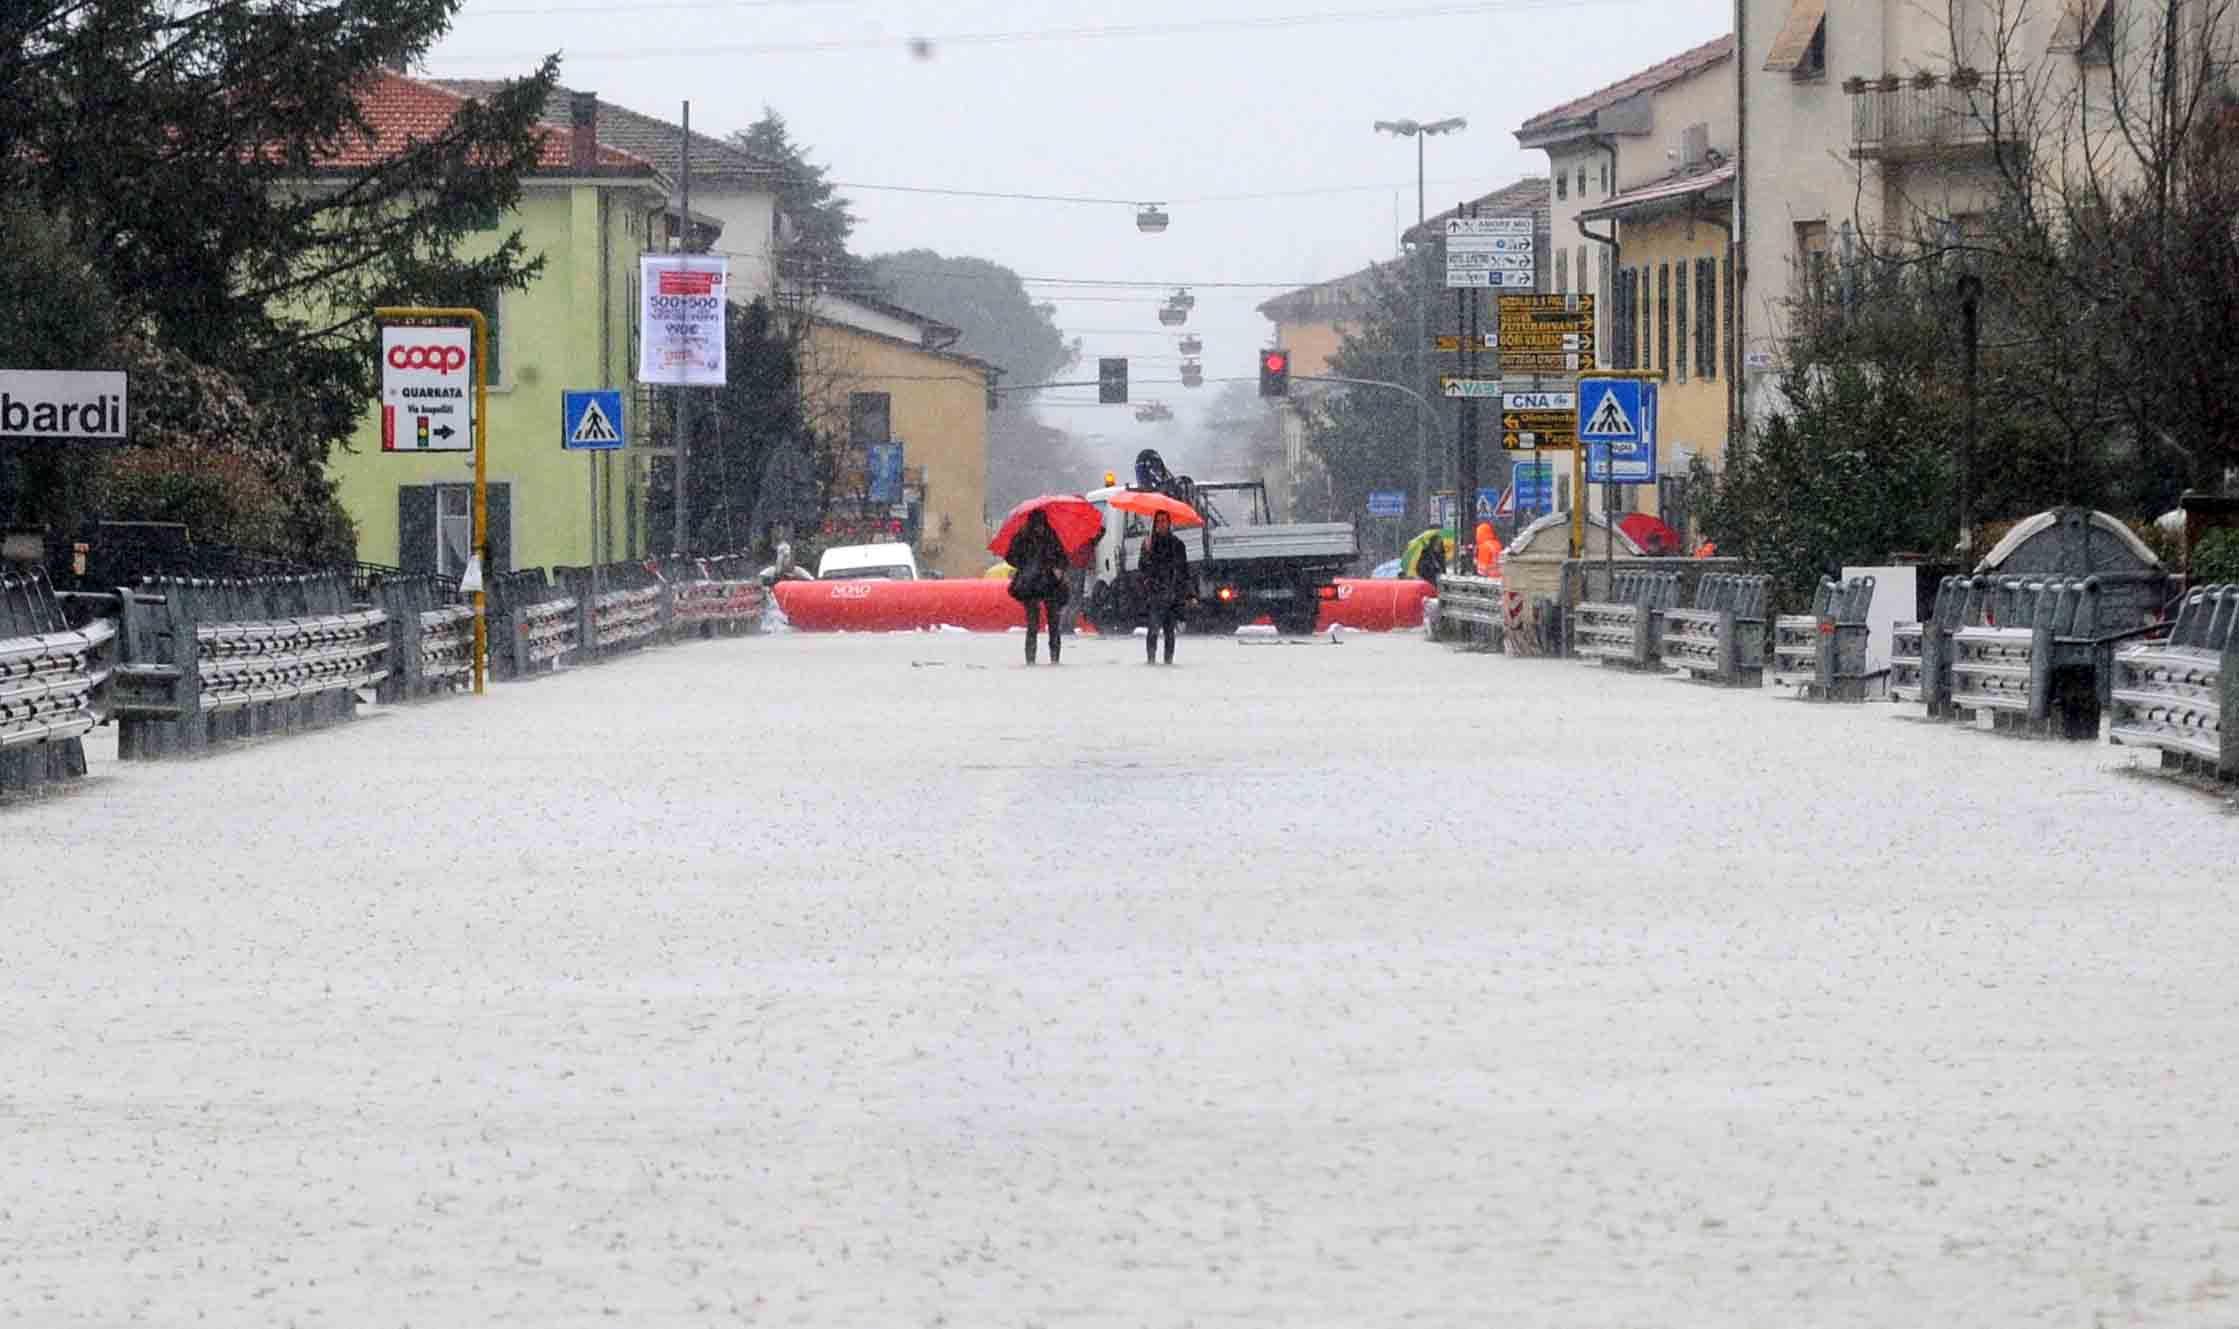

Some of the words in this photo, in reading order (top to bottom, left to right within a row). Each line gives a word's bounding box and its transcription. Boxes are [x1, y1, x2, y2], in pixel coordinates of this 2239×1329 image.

[387, 345, 466, 376] coop
[1, 393, 120, 433] bardi
[1512, 395, 1550, 408] CNA
